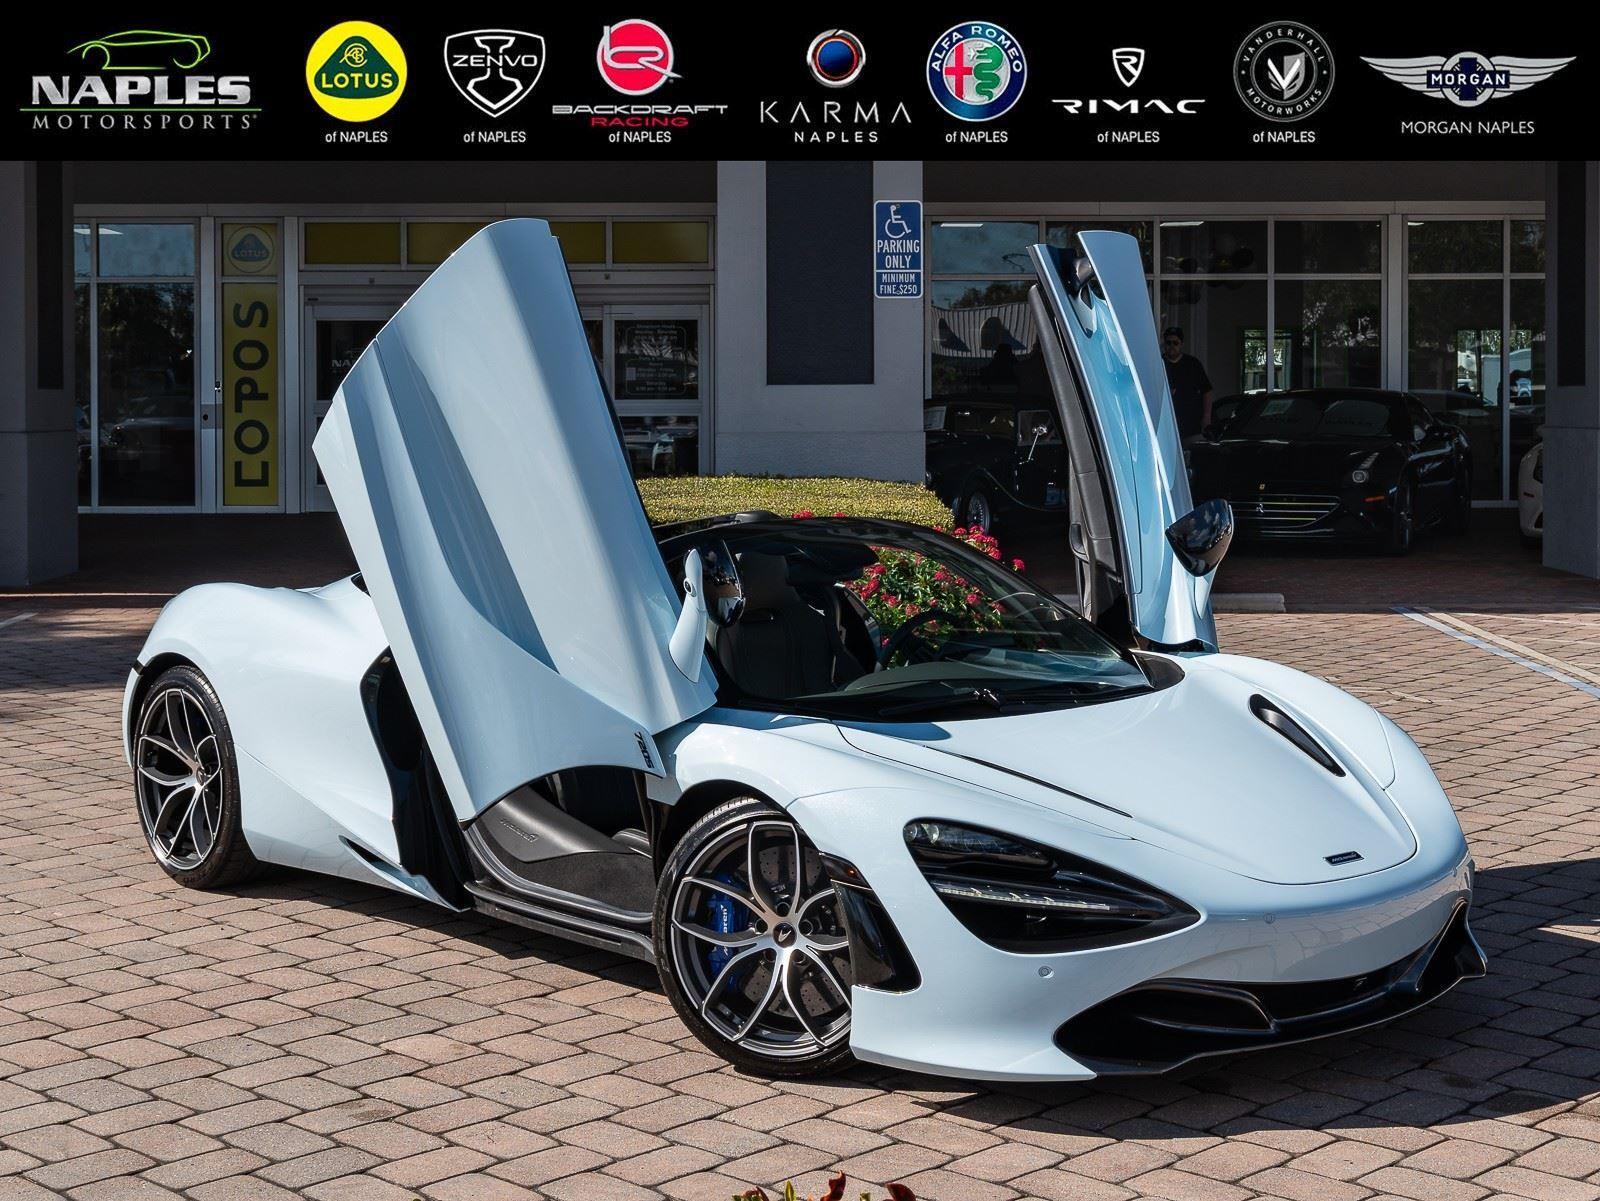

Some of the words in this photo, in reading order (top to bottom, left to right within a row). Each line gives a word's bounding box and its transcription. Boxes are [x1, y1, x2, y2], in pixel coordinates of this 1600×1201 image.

[877, 240, 920, 253] PARKING
[885, 255, 912, 269] ONLY
[882, 273, 915, 283] MINIMUM
[880, 284, 897, 294] FINE
[899, 284, 918, 295] $250
[634, 731, 655, 769] 720S
